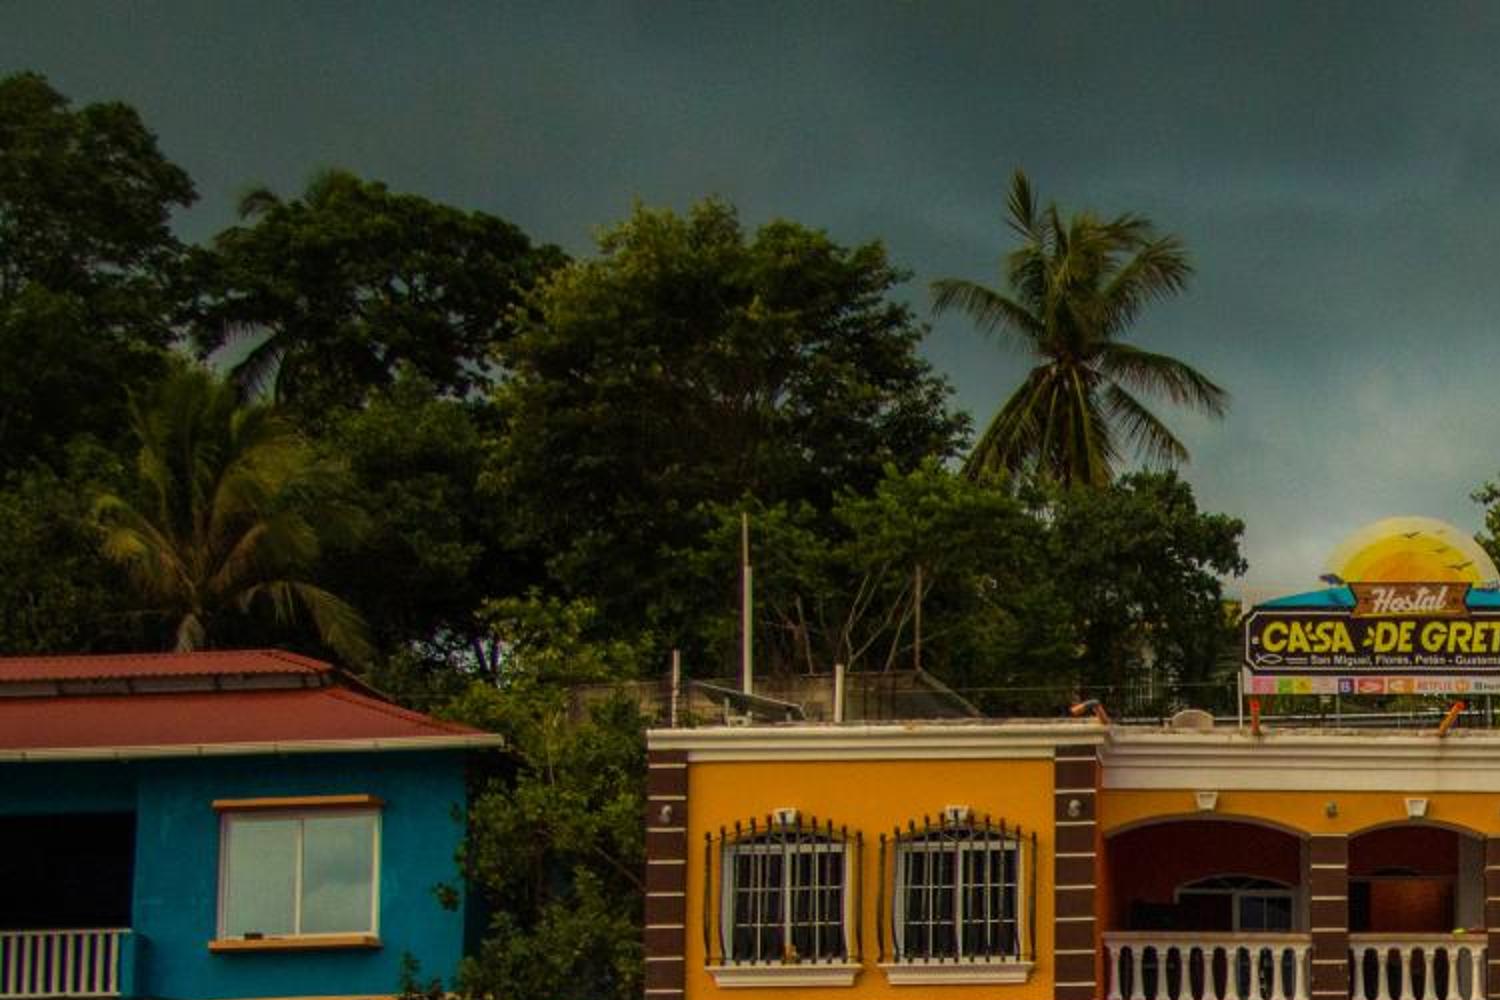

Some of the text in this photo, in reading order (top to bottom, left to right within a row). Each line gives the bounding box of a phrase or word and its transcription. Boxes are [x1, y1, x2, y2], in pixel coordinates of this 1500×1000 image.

[1371, 584, 1448, 613] Hostal
[1262, 620, 1355, 653] CASA
[1373, 620, 1417, 653] DE
[1310, 655, 1331, 665] San
